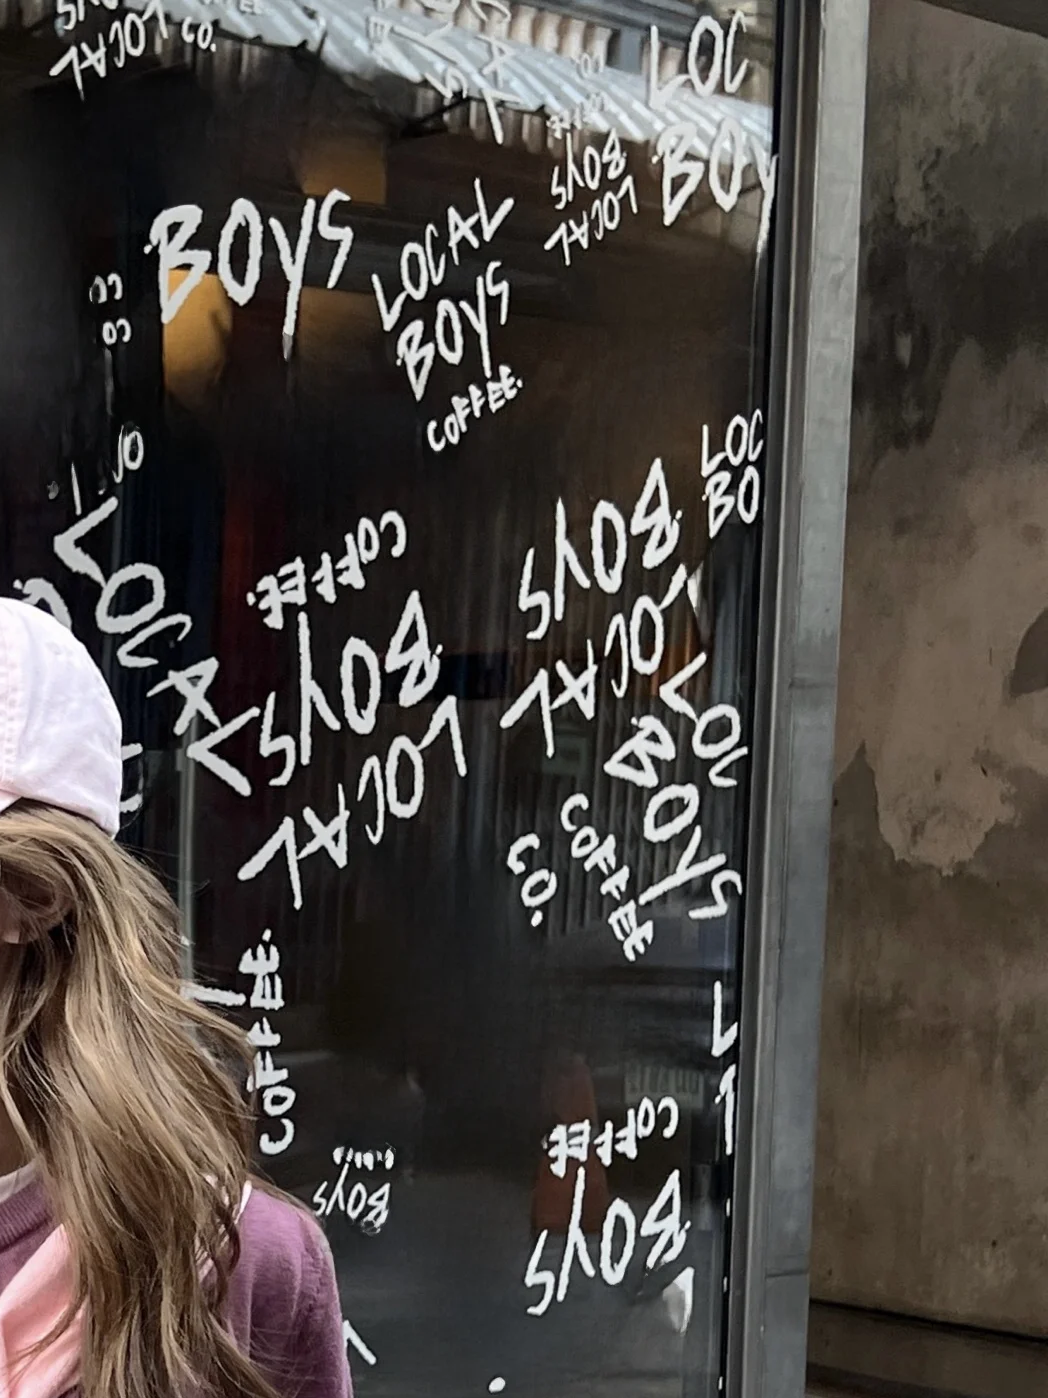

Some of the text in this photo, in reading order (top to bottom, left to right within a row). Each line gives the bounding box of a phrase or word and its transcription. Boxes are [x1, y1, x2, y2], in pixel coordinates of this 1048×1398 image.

[144, 188, 354, 361] BOYS
[371, 177, 515, 332] LOCAL
[544, 174, 638, 267] LOCAL
[396, 260, 509, 401] BOYS
[518, 457, 683, 640] BOYS
[54, 496, 260, 797] LOCAL
[259, 589, 444, 787] BOYS
[499, 562, 700, 759] LOCAL
[237, 694, 467, 911] LOCAL
[603, 714, 744, 921] BOYS
[524, 1167, 692, 1316] BOYS
